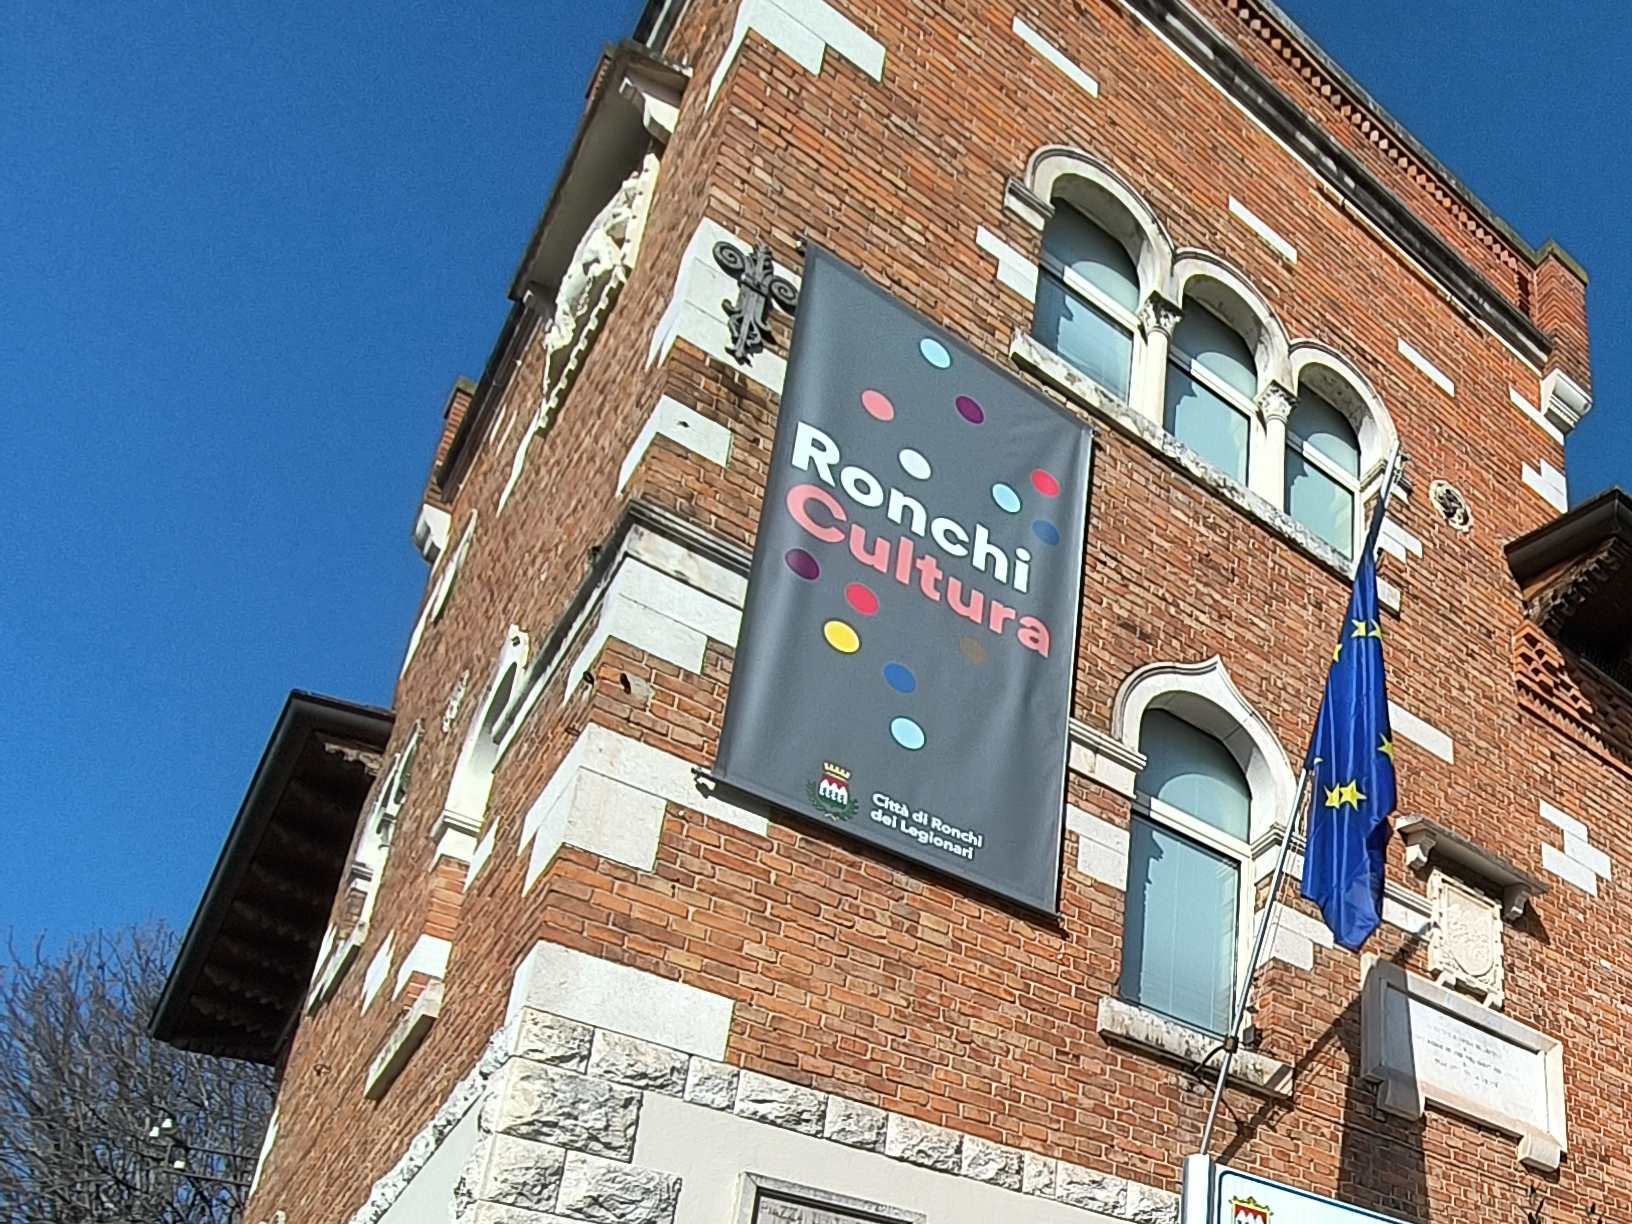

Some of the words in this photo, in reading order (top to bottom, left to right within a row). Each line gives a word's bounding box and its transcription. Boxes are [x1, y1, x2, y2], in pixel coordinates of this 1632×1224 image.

[791, 421, 1032, 593] Ronchi
[786, 484, 1051, 658] Cultura
[870, 809, 898, 829] dei
[900, 819, 974, 860] Legionari
[872, 793, 909, 818] Città
[912, 811, 928, 826] di
[931, 817, 982, 848] Ronchi
